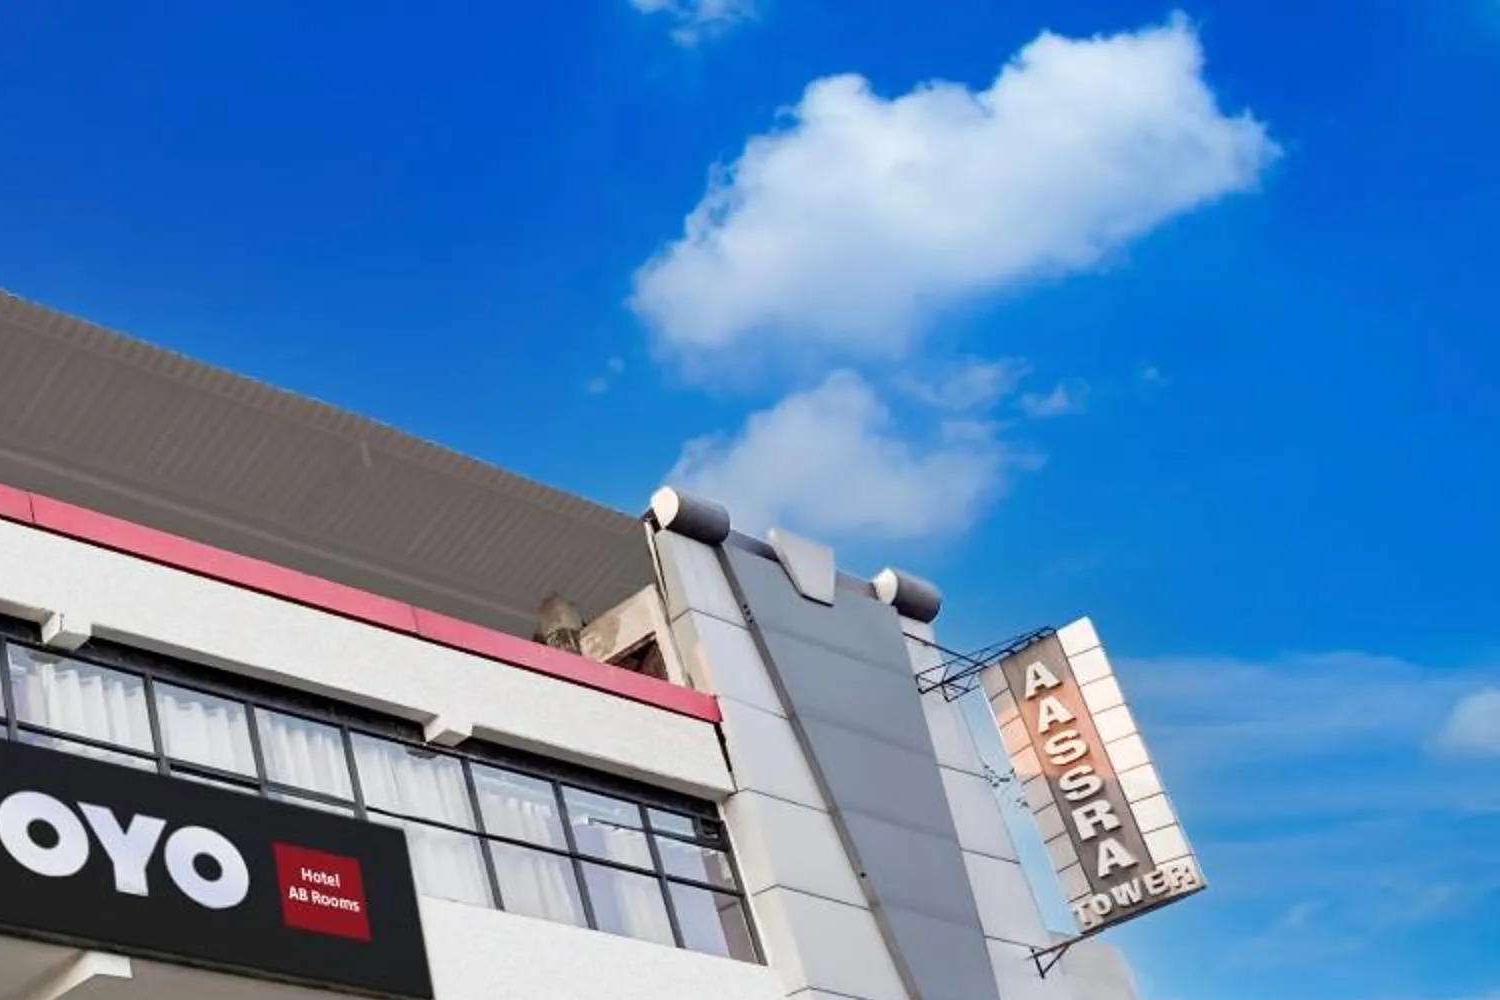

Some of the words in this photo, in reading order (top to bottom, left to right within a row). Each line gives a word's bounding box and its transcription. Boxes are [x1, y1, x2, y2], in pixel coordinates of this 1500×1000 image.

[1024, 660, 1140, 879] AASSRA
[289, 886, 308, 902] AB
[311, 889, 361, 912] Rooms
[301, 867, 340, 888] Hotel
[1072, 861, 1198, 926] TOWER
